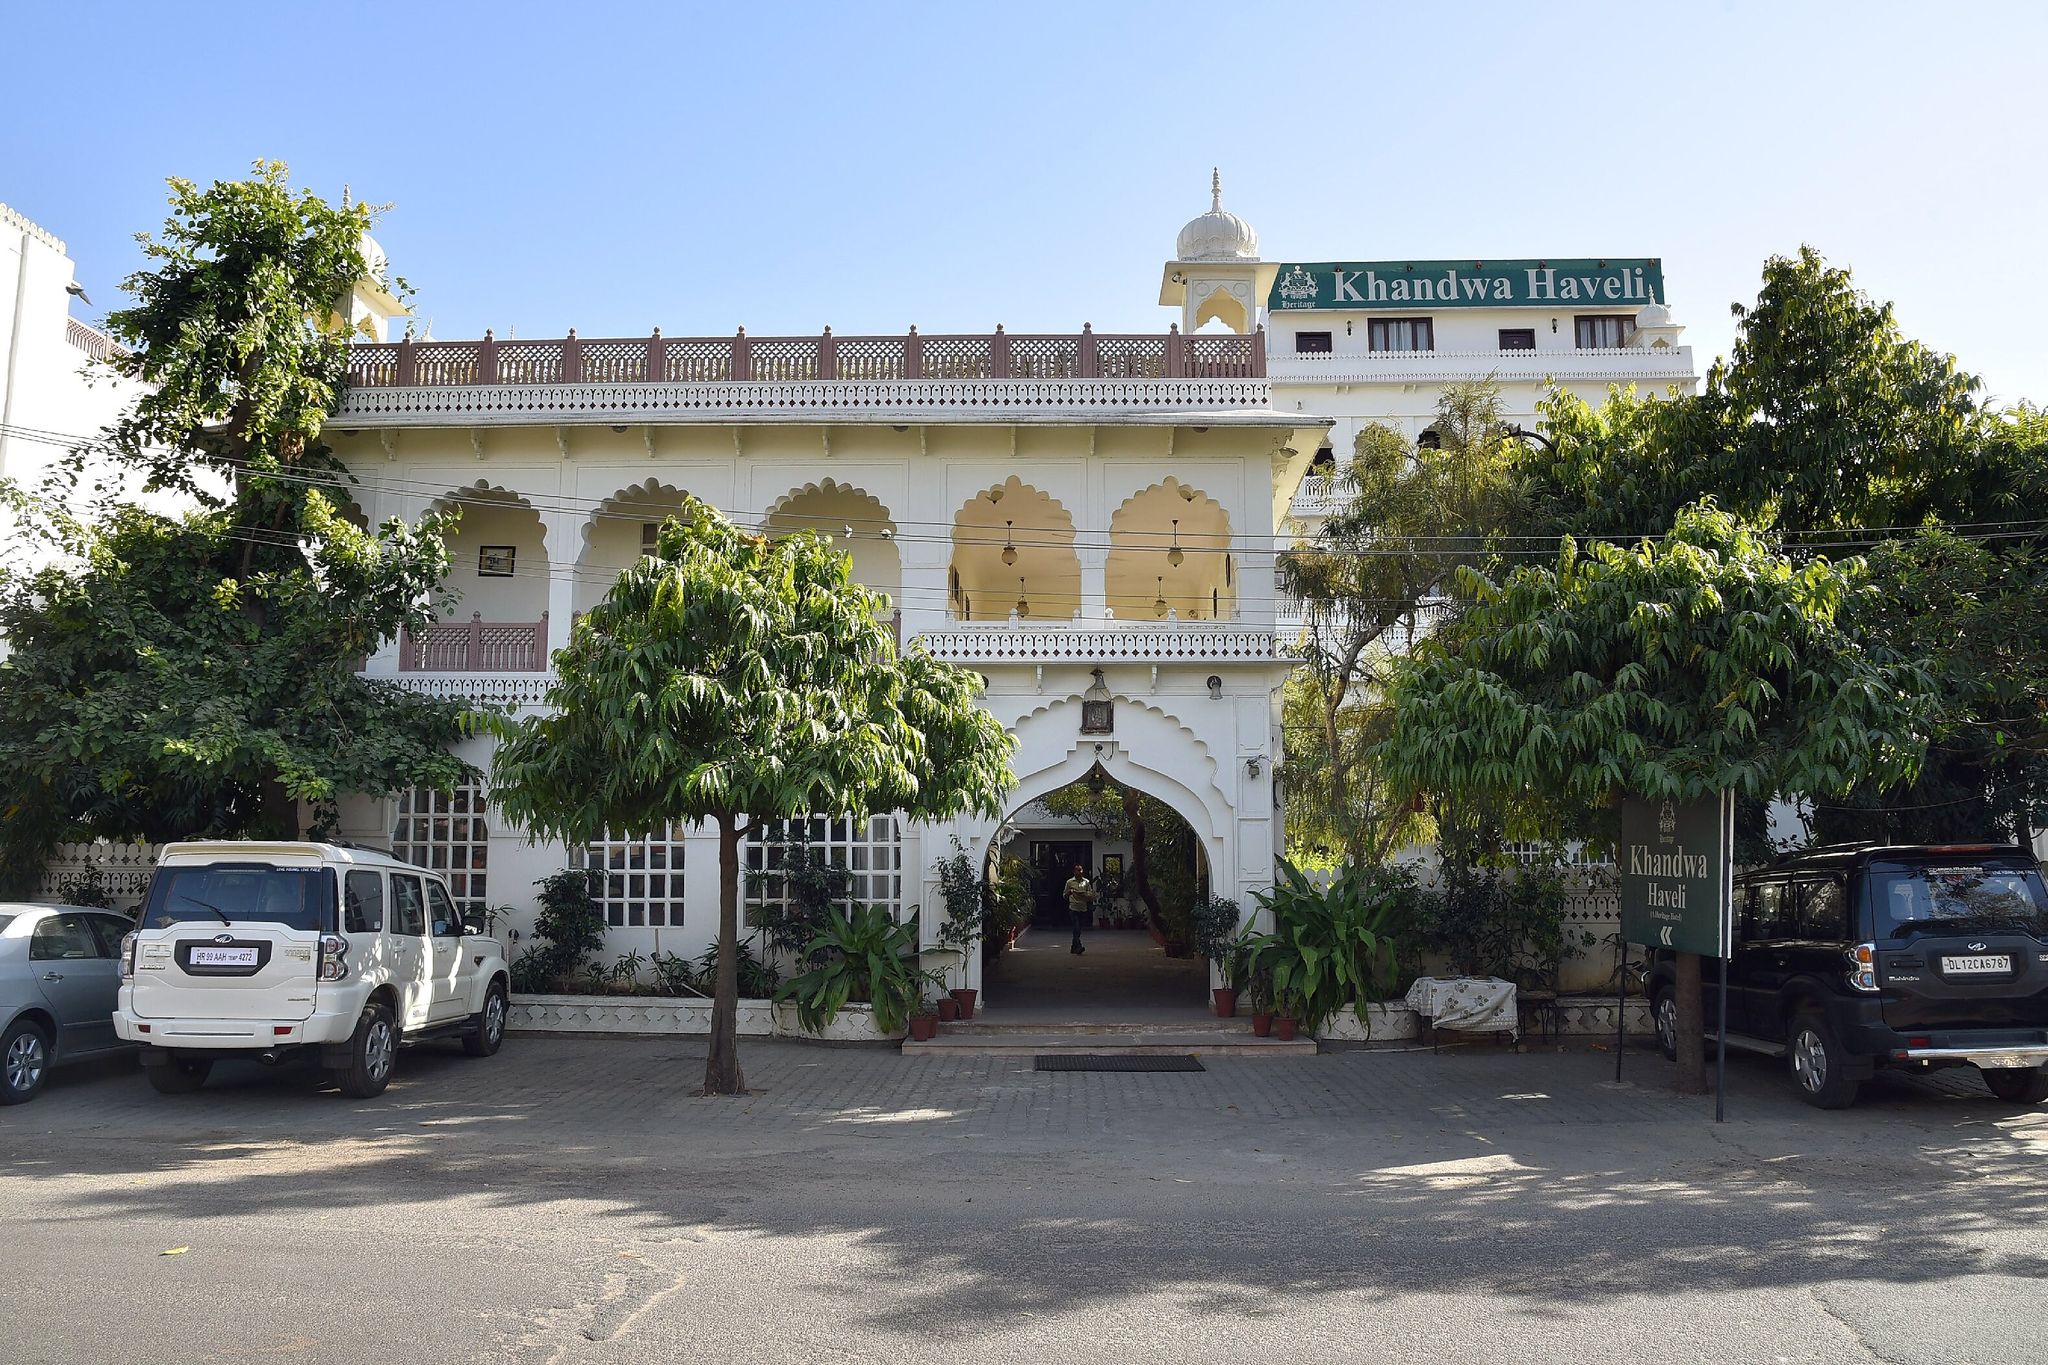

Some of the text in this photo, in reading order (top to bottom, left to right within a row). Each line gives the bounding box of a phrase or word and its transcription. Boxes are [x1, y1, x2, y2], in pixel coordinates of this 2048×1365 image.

[1332, 267, 1647, 302] Khandwa Haveli
[1281, 300, 1316, 309] Heritage
[1629, 845, 1708, 879] Khandwa
[1647, 882, 1686, 909] Haveli
[197, 952, 205, 961] HR
[213, 952, 227, 961] AAH
[238, 952, 252, 962] 4272
[1949, 958, 2009, 970] DL12CA6787
